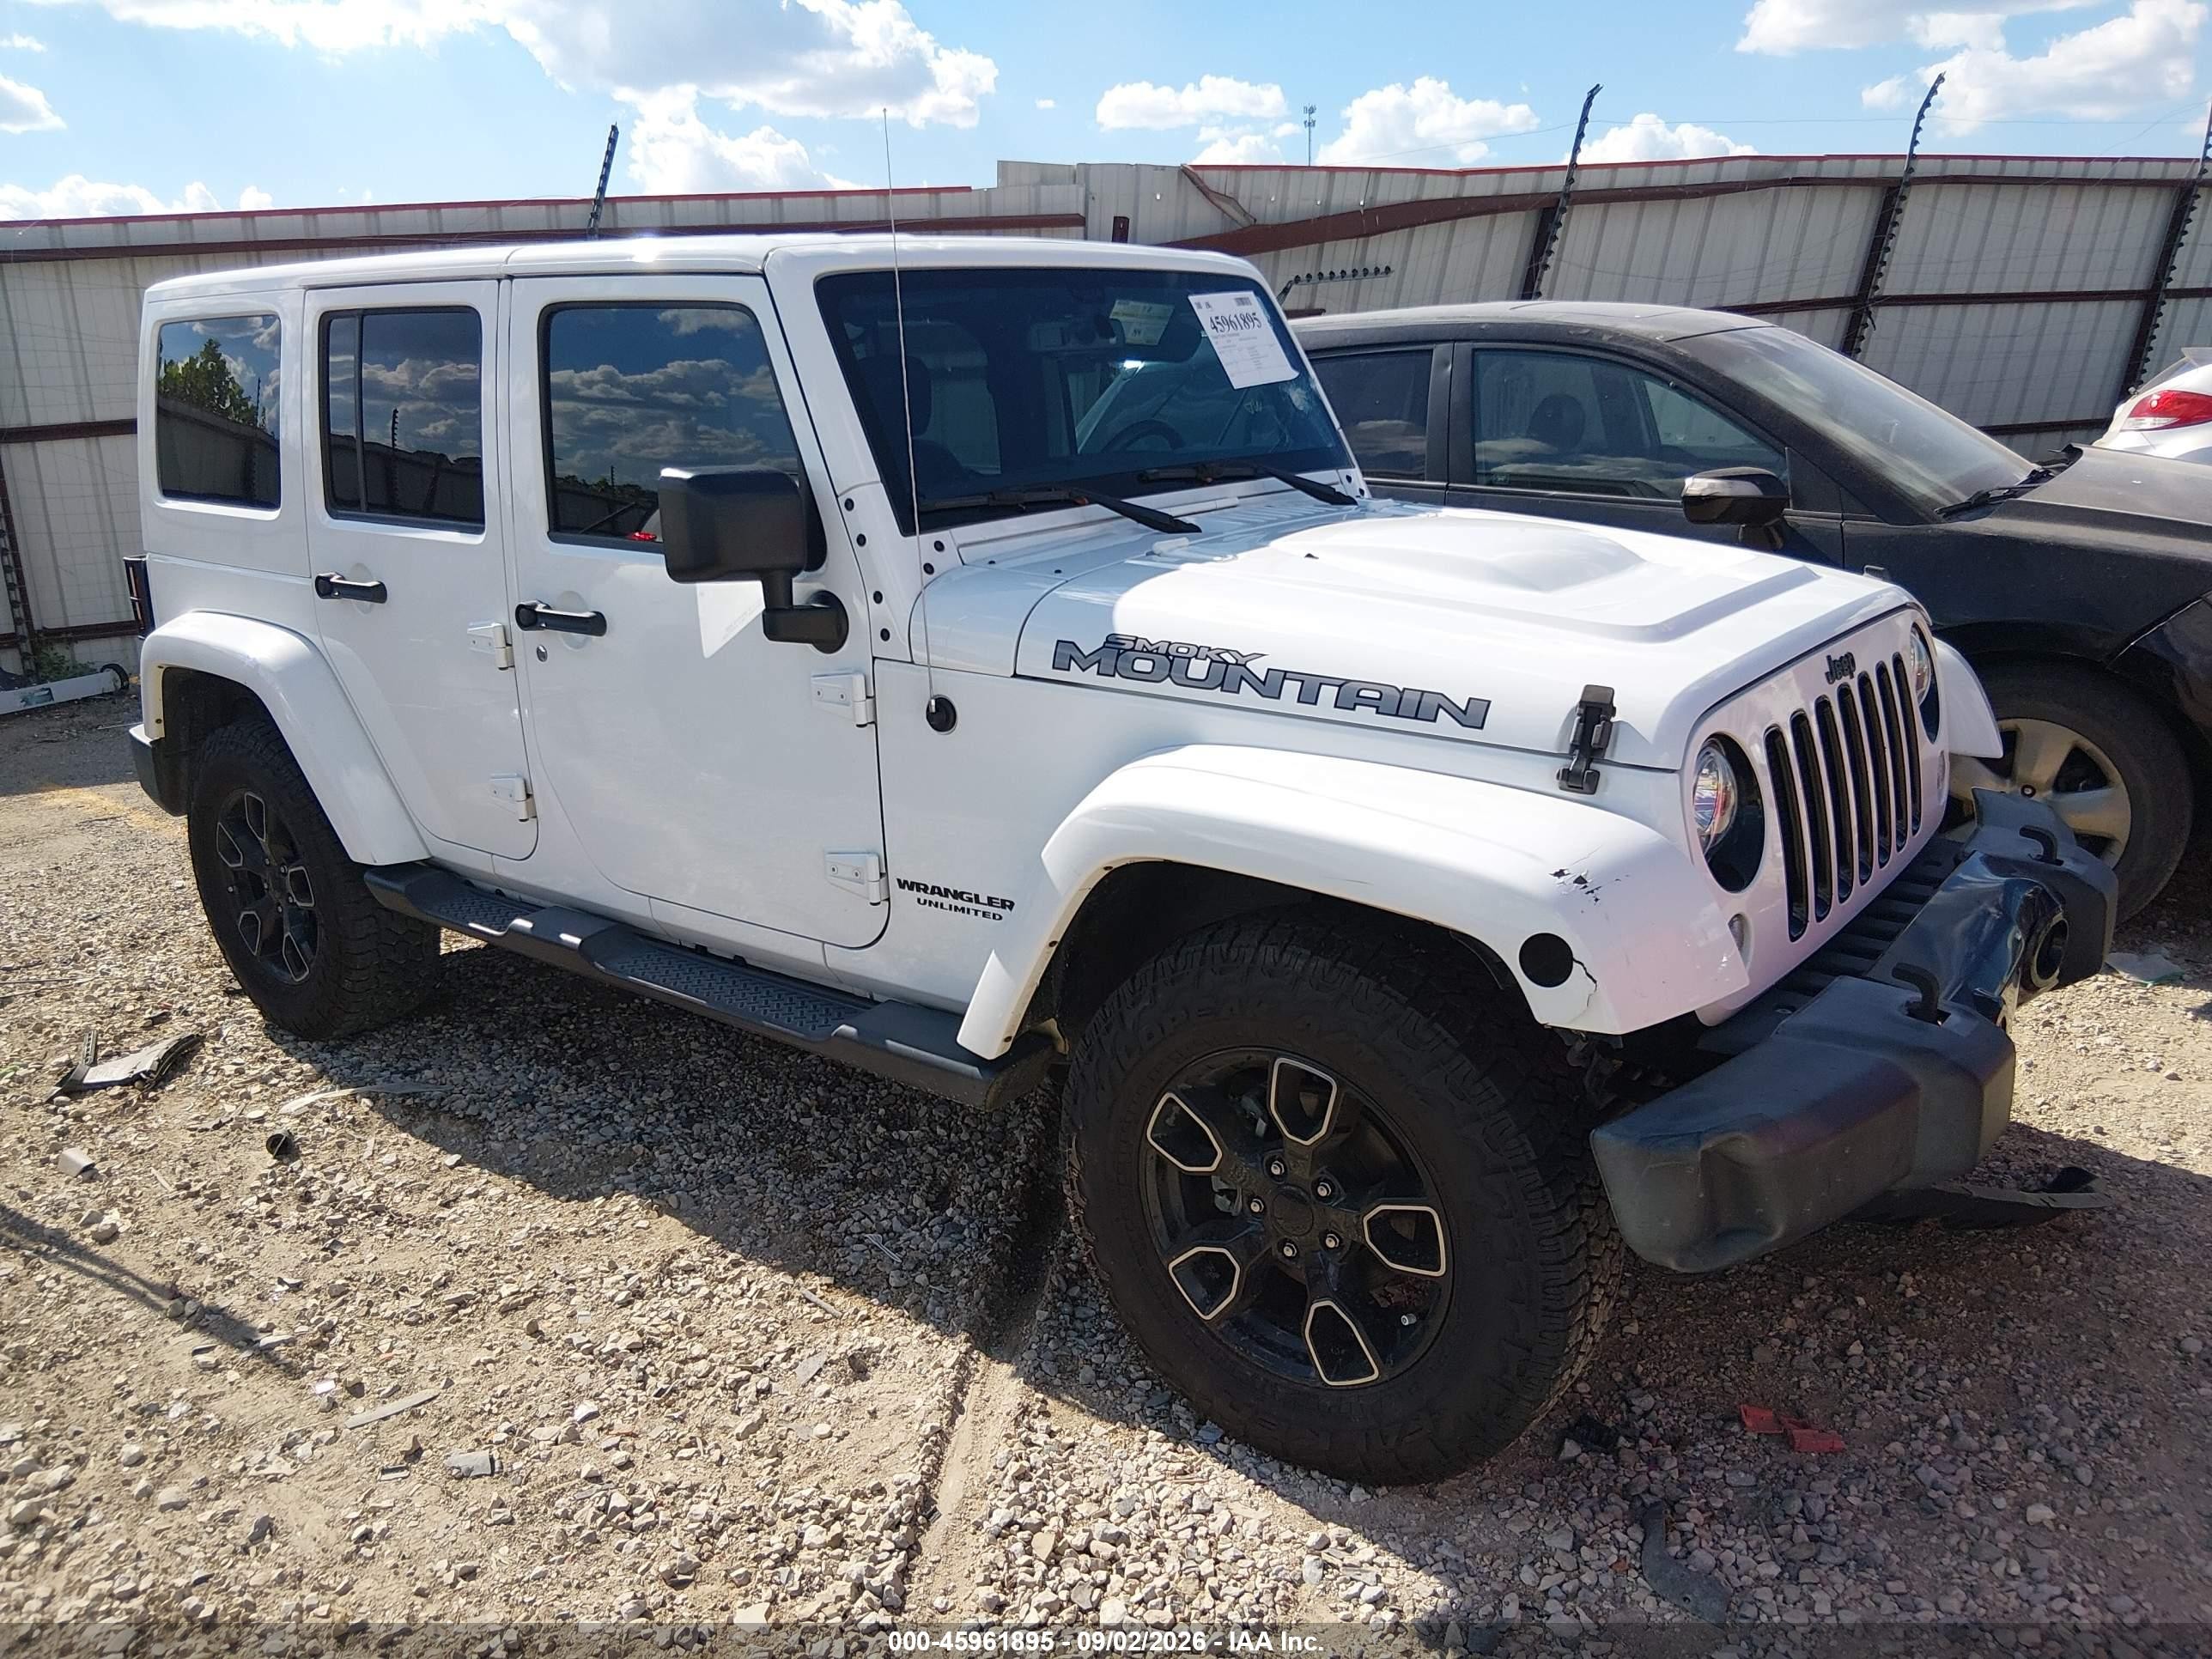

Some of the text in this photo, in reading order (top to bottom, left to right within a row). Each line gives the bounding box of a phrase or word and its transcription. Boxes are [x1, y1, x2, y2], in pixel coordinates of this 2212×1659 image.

[1210, 313, 1262, 333] 45961895
[1104, 634, 1269, 664] SMOKY
[1826, 653, 1856, 684] Jeep
[1052, 640, 1492, 730] MOUNTAIN
[896, 878, 1015, 912] WRANGLER
[916, 897, 1003, 921] UNLIMITED
